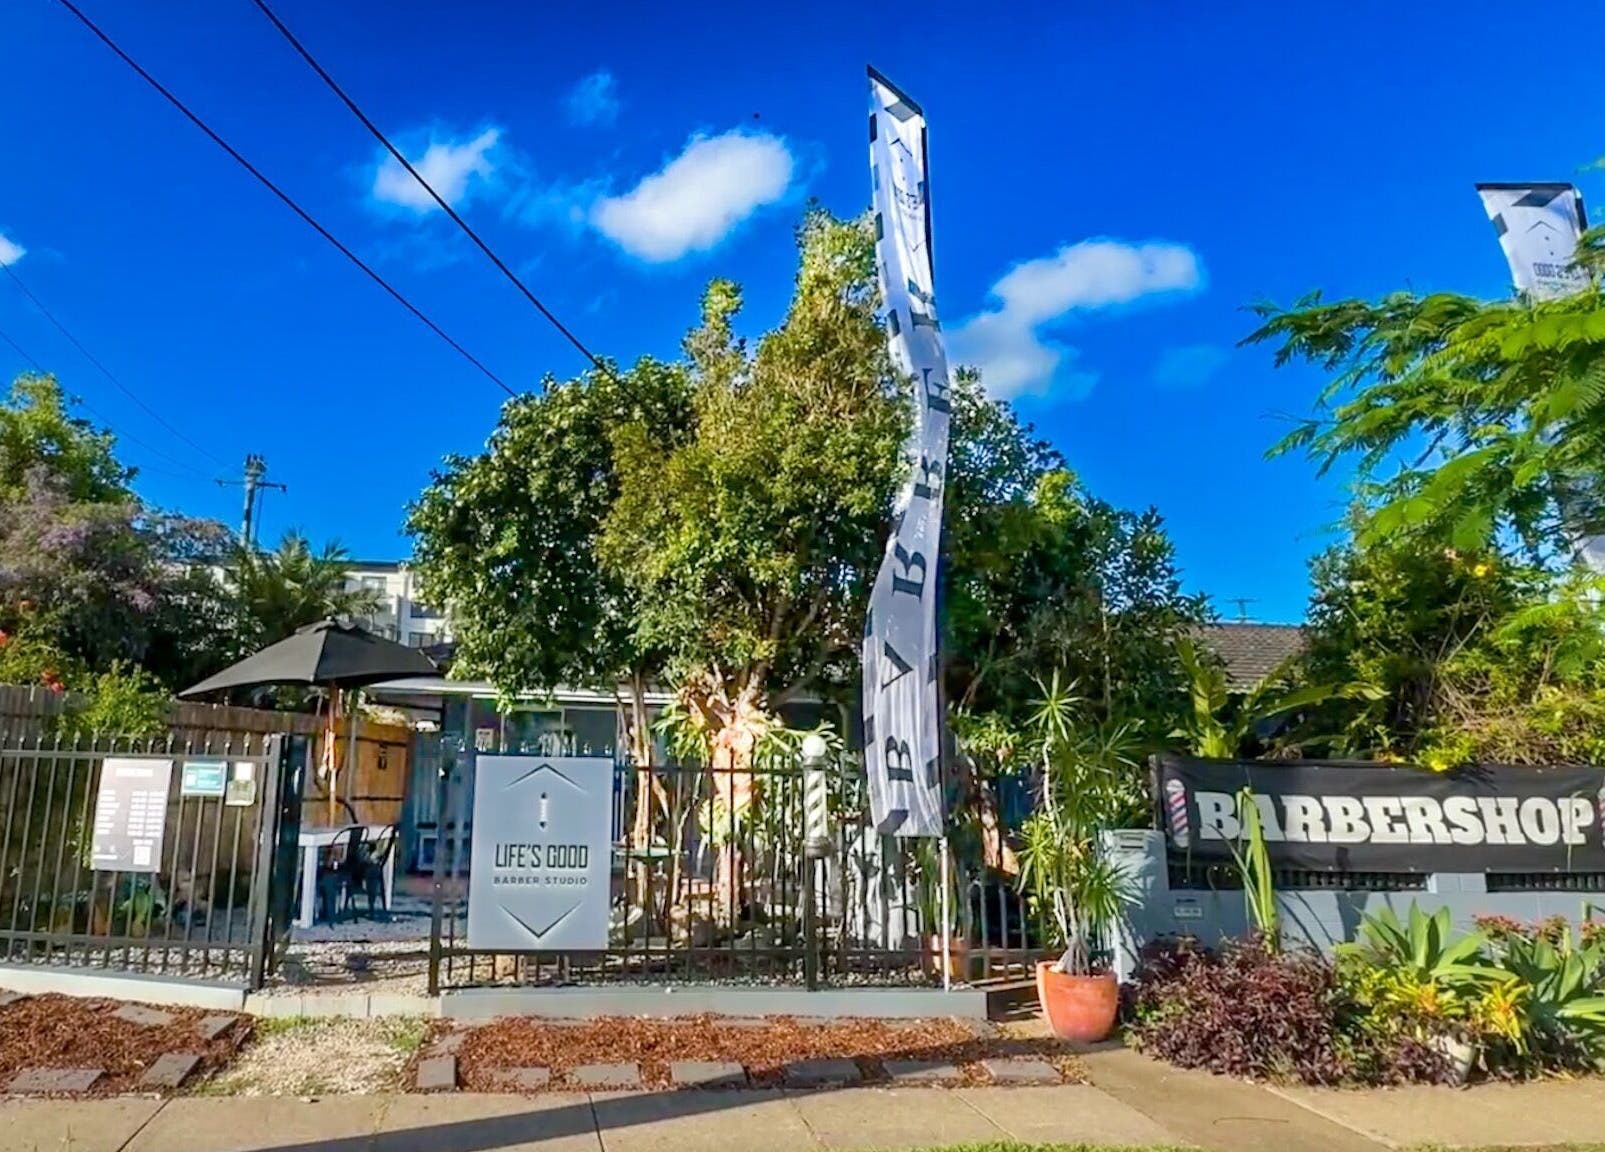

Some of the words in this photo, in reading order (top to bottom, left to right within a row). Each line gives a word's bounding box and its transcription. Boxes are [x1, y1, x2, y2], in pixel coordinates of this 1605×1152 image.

[1194, 791, 1594, 846] BARBERSHOP
[495, 843, 541, 868] LIFE'S
[547, 844, 588, 868] GOOD
[494, 876, 540, 885] BARBER
[544, 876, 587, 885] STUDIO
